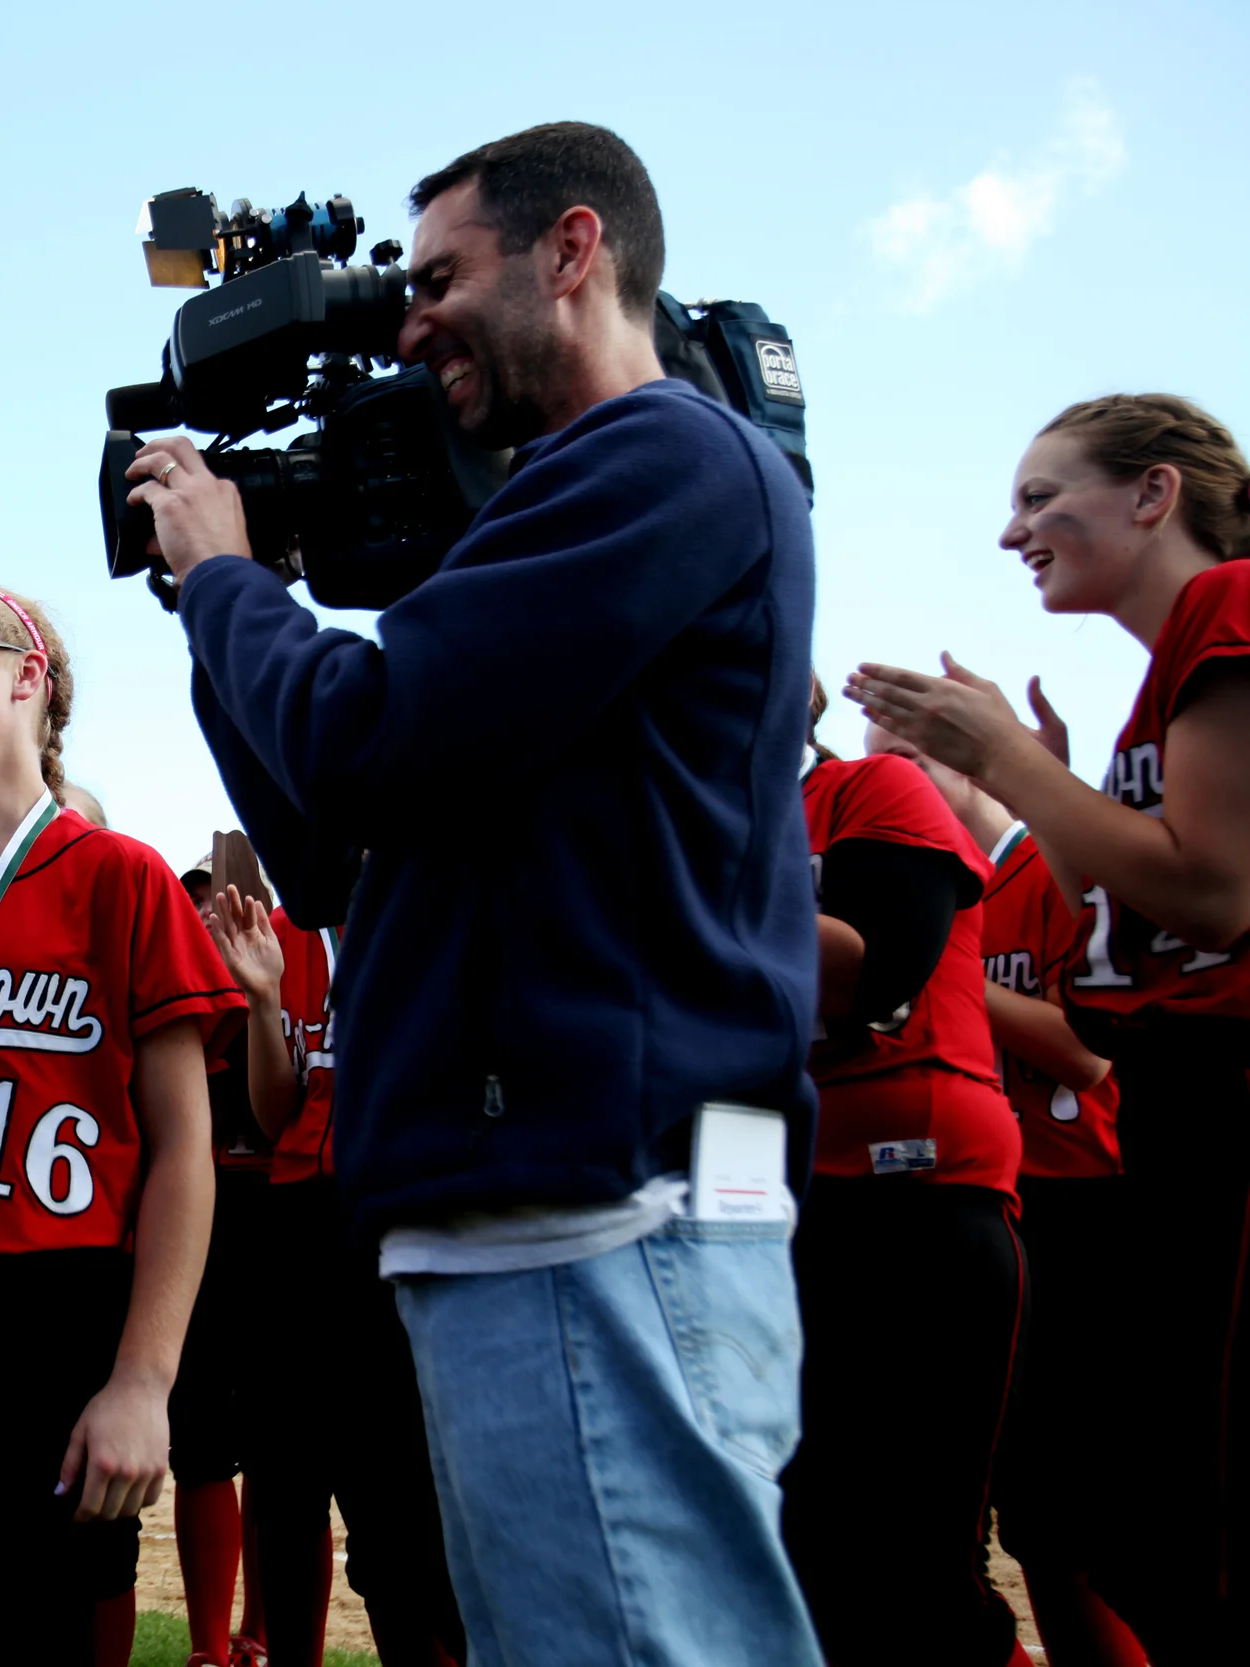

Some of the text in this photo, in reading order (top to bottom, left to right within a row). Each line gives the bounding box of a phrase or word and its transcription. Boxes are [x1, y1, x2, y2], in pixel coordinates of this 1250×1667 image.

[247, 298, 262, 310] HD
[7, 599, 46, 650] UNDER ARMOUR
